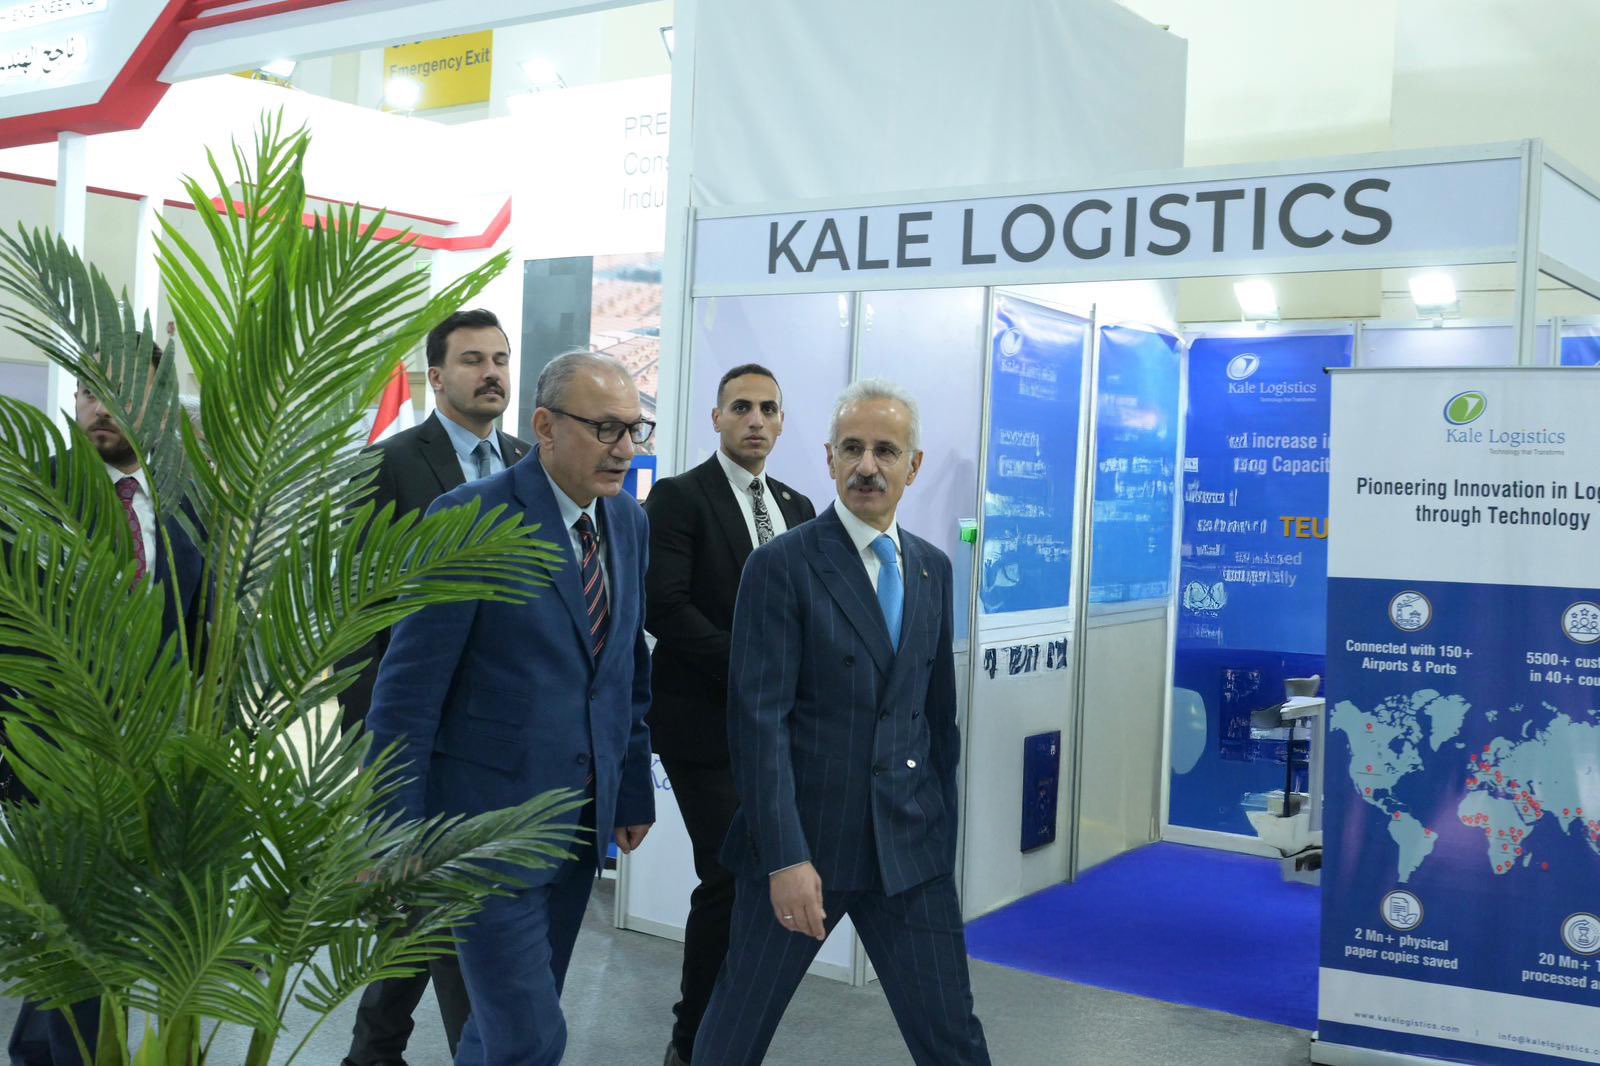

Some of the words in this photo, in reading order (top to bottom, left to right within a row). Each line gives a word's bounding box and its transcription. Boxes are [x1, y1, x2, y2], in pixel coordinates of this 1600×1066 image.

[390, 55, 463, 77] Emergency
[465, 48, 491, 66] Exit
[624, 112, 667, 139] PRE
[767, 211, 933, 275] KALE
[960, 178, 1393, 266] LOGISTICS
[1228, 381, 1256, 394] Kale
[1260, 381, 1317, 397] Logistics
[1252, 433, 1317, 449] increase
[1446, 428, 1483, 444] Kale
[1489, 428, 1566, 447] Logistics
[1356, 477, 1447, 500] Pioneering
[1454, 479, 1545, 499] Innovation
[1552, 481, 1568, 499] in
[1280, 516, 1329, 540] TEU
[1416, 505, 1481, 527] through
[1488, 506, 1591, 531] Technology
[1346, 640, 1407, 655] Connected
[1410, 643, 1436, 657] with
[1439, 645, 1473, 659] 150+
[1526, 651, 1571, 666] 5500+
[1362, 658, 1409, 673] Airports
[1412, 660, 1422, 672] &
[1426, 661, 1457, 675] Ports
[1529, 669, 1542, 682] in
[1545, 671, 1574, 684] 40+
[1354, 927, 1362, 939] 2
[1366, 929, 1395, 944] Mn+
[1399, 934, 1449, 952] physical
[1344, 945, 1378, 959] paper
[1381, 950, 1420, 965] copies
[1423, 956, 1459, 970] saved
[1538, 952, 1555, 966] 20
[1558, 955, 1591, 970] Mn+
[1521, 970, 1587, 988] processed
[1590, 979, 1600, 990] a
[1354, 1011, 1460, 1034] www.kalelogistics.com
